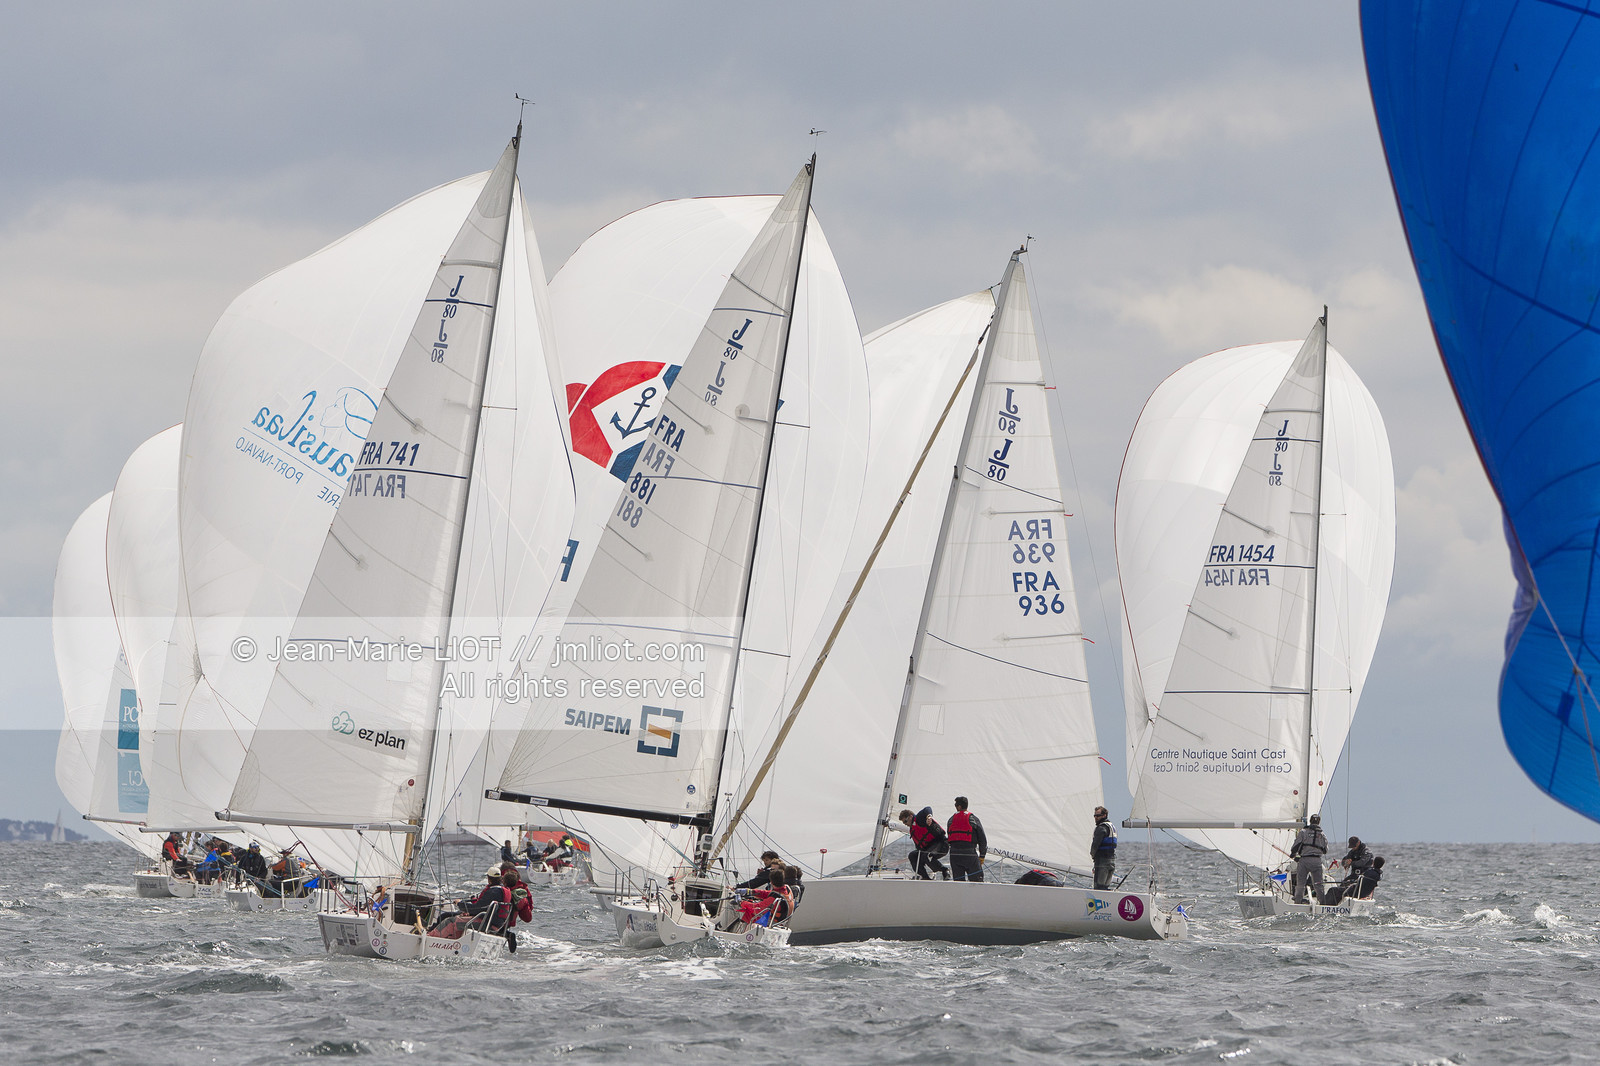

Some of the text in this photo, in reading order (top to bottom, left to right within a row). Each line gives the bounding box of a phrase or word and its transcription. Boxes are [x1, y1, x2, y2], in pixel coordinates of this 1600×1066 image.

[449, 275, 465, 298] J
[442, 303, 457, 319] 80
[731, 318, 753, 341] J
[723, 346, 738, 361] 80
[654, 414, 686, 453] FRA
[1277, 419, 1289, 437] J
[358, 441, 420, 467] FRA 741
[993, 438, 1014, 461] J
[1274, 441, 1288, 453] 80
[987, 464, 1007, 482] 80
[629, 471, 657, 505] 881
[1208, 544, 1275, 563] FRA 1454
[1012, 570, 1061, 593] FRA
[1018, 593, 1065, 617] 936
[564, 708, 632, 736] SAIPEM
[358, 728, 406, 750] ez plan
[1150, 748, 1287, 761] Centre Nautique Saint Cast
